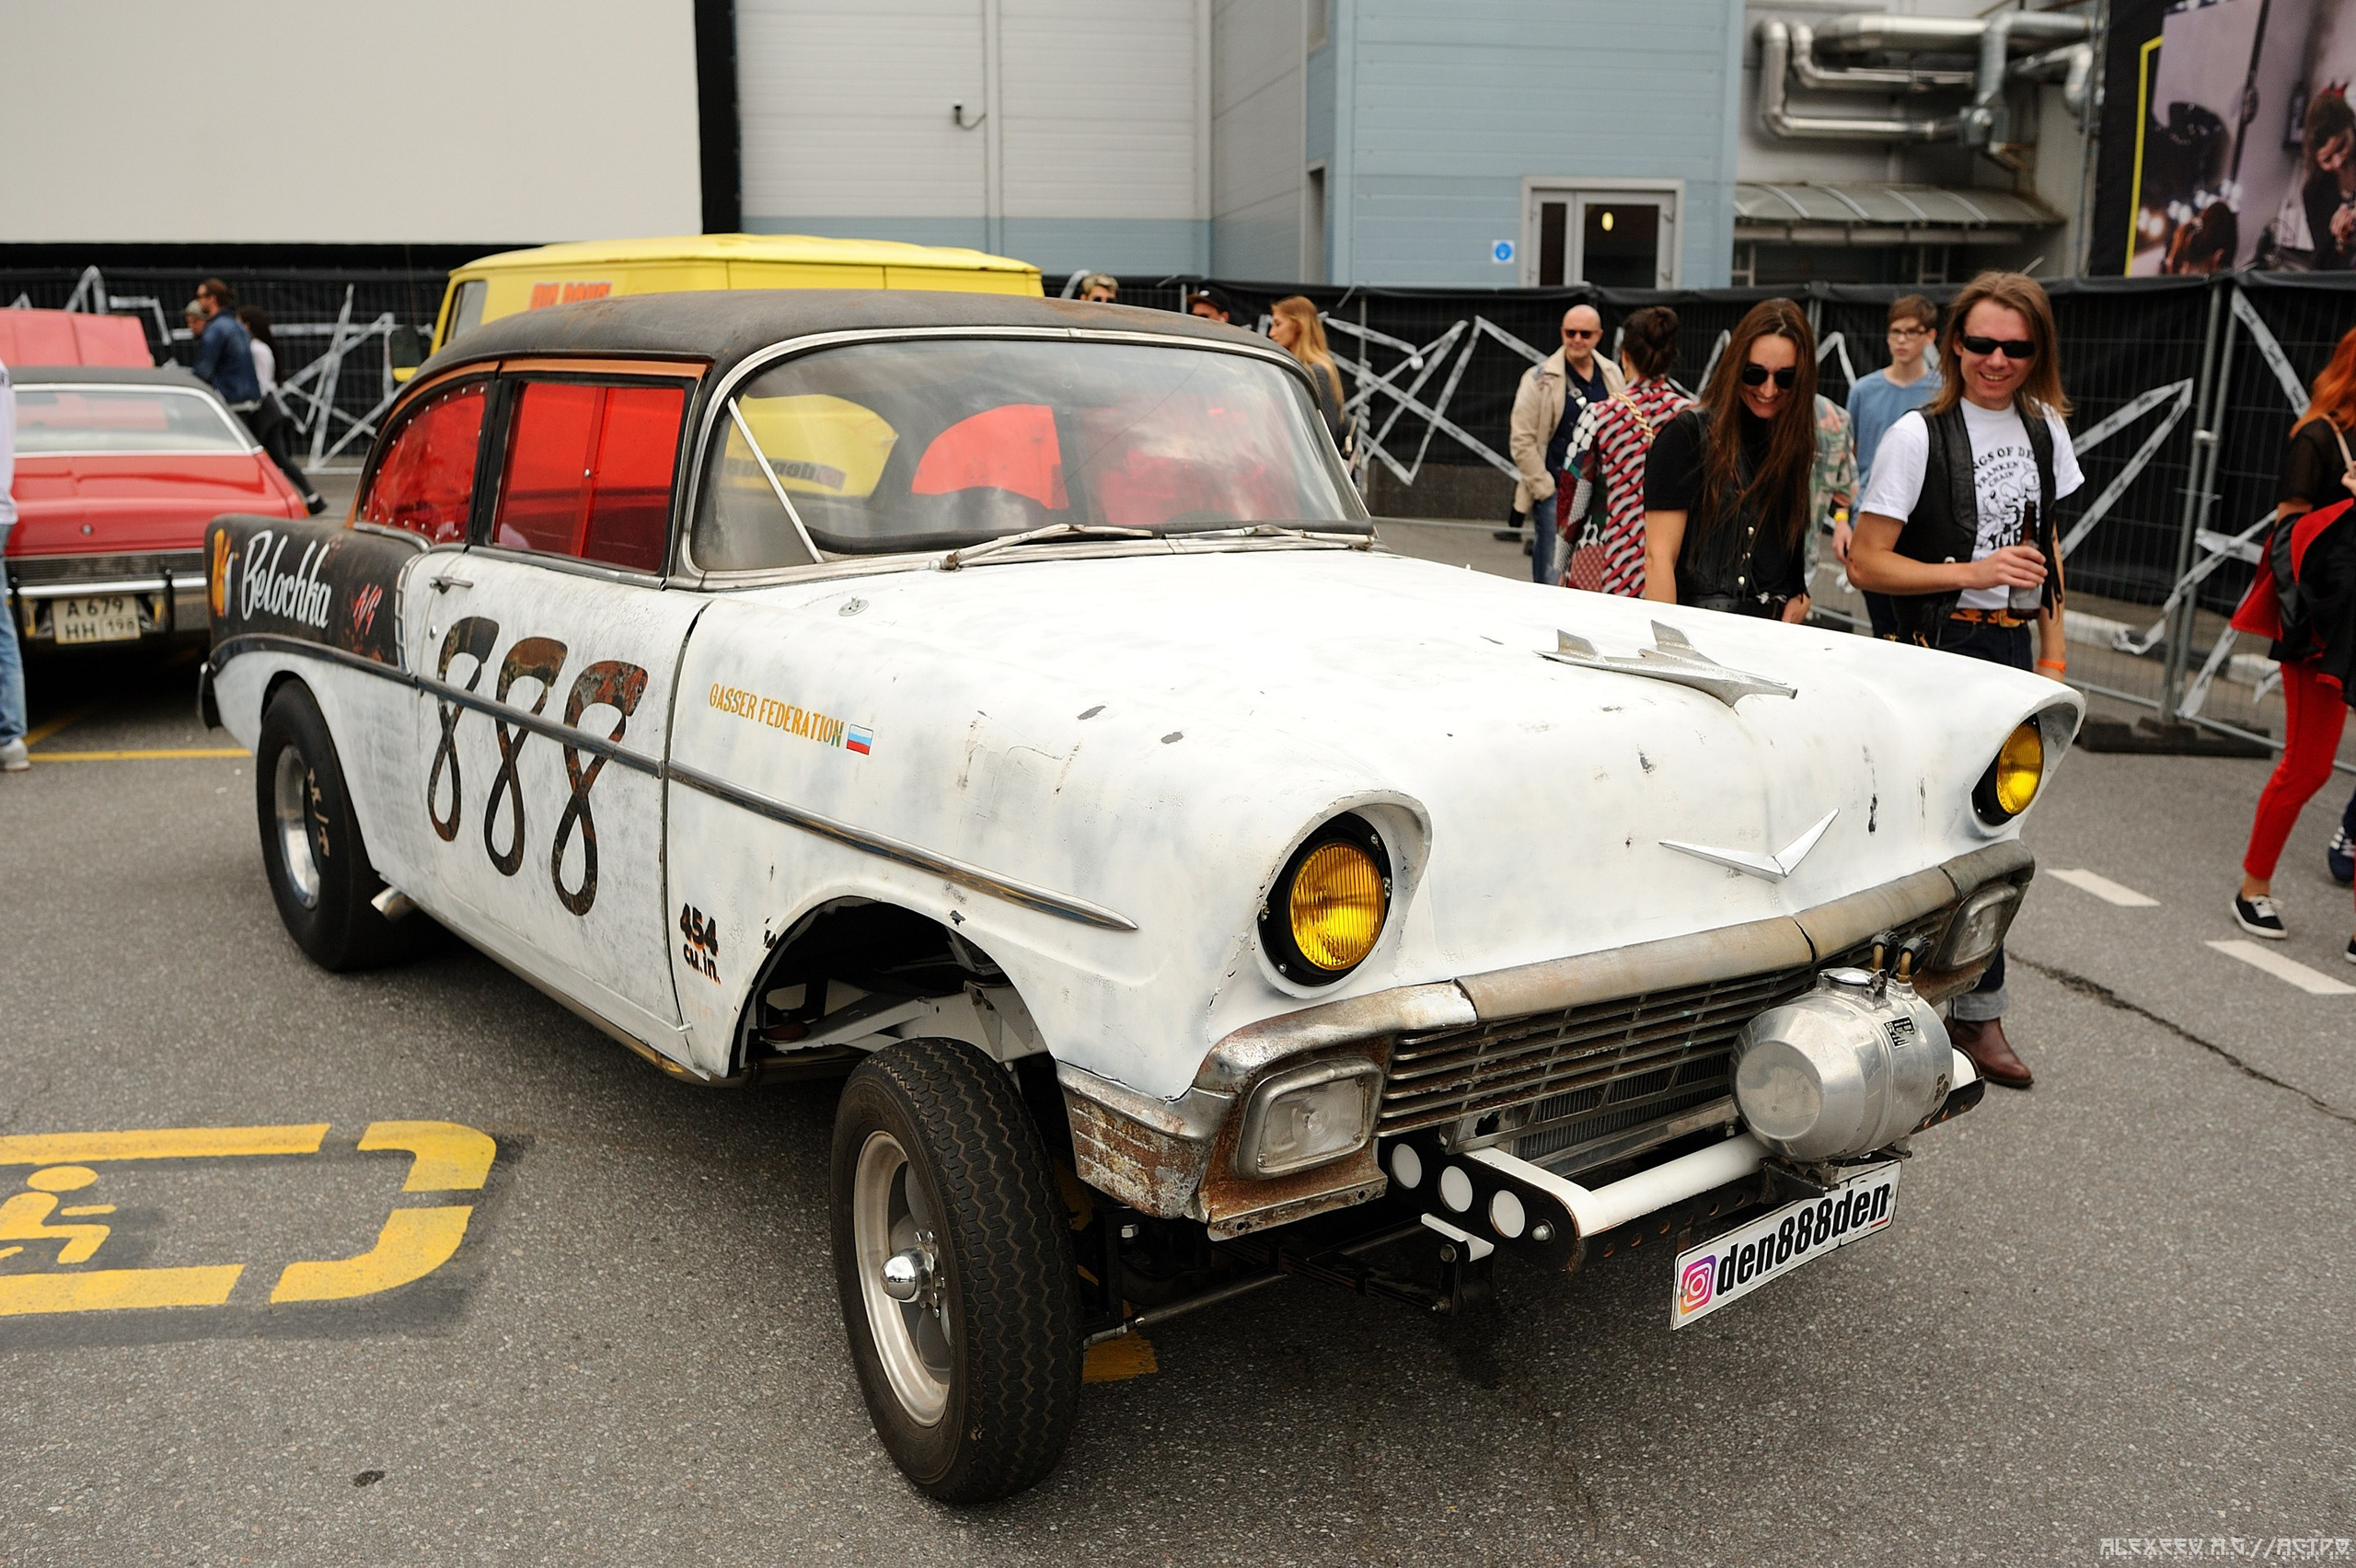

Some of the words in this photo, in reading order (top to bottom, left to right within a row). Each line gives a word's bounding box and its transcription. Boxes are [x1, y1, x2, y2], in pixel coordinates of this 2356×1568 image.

[1997, 446, 2014, 458] OF
[67, 598, 80, 617] A
[87, 596, 123, 616] 679
[241, 529, 332, 628] Belochka
[65, 623, 97, 639] HH
[710, 683, 757, 720] GASSER
[758, 698, 845, 747] FEDERATION
[427, 616, 649, 917] 888
[680, 903, 719, 957] 454
[1716, 1183, 1891, 1296] den888den
